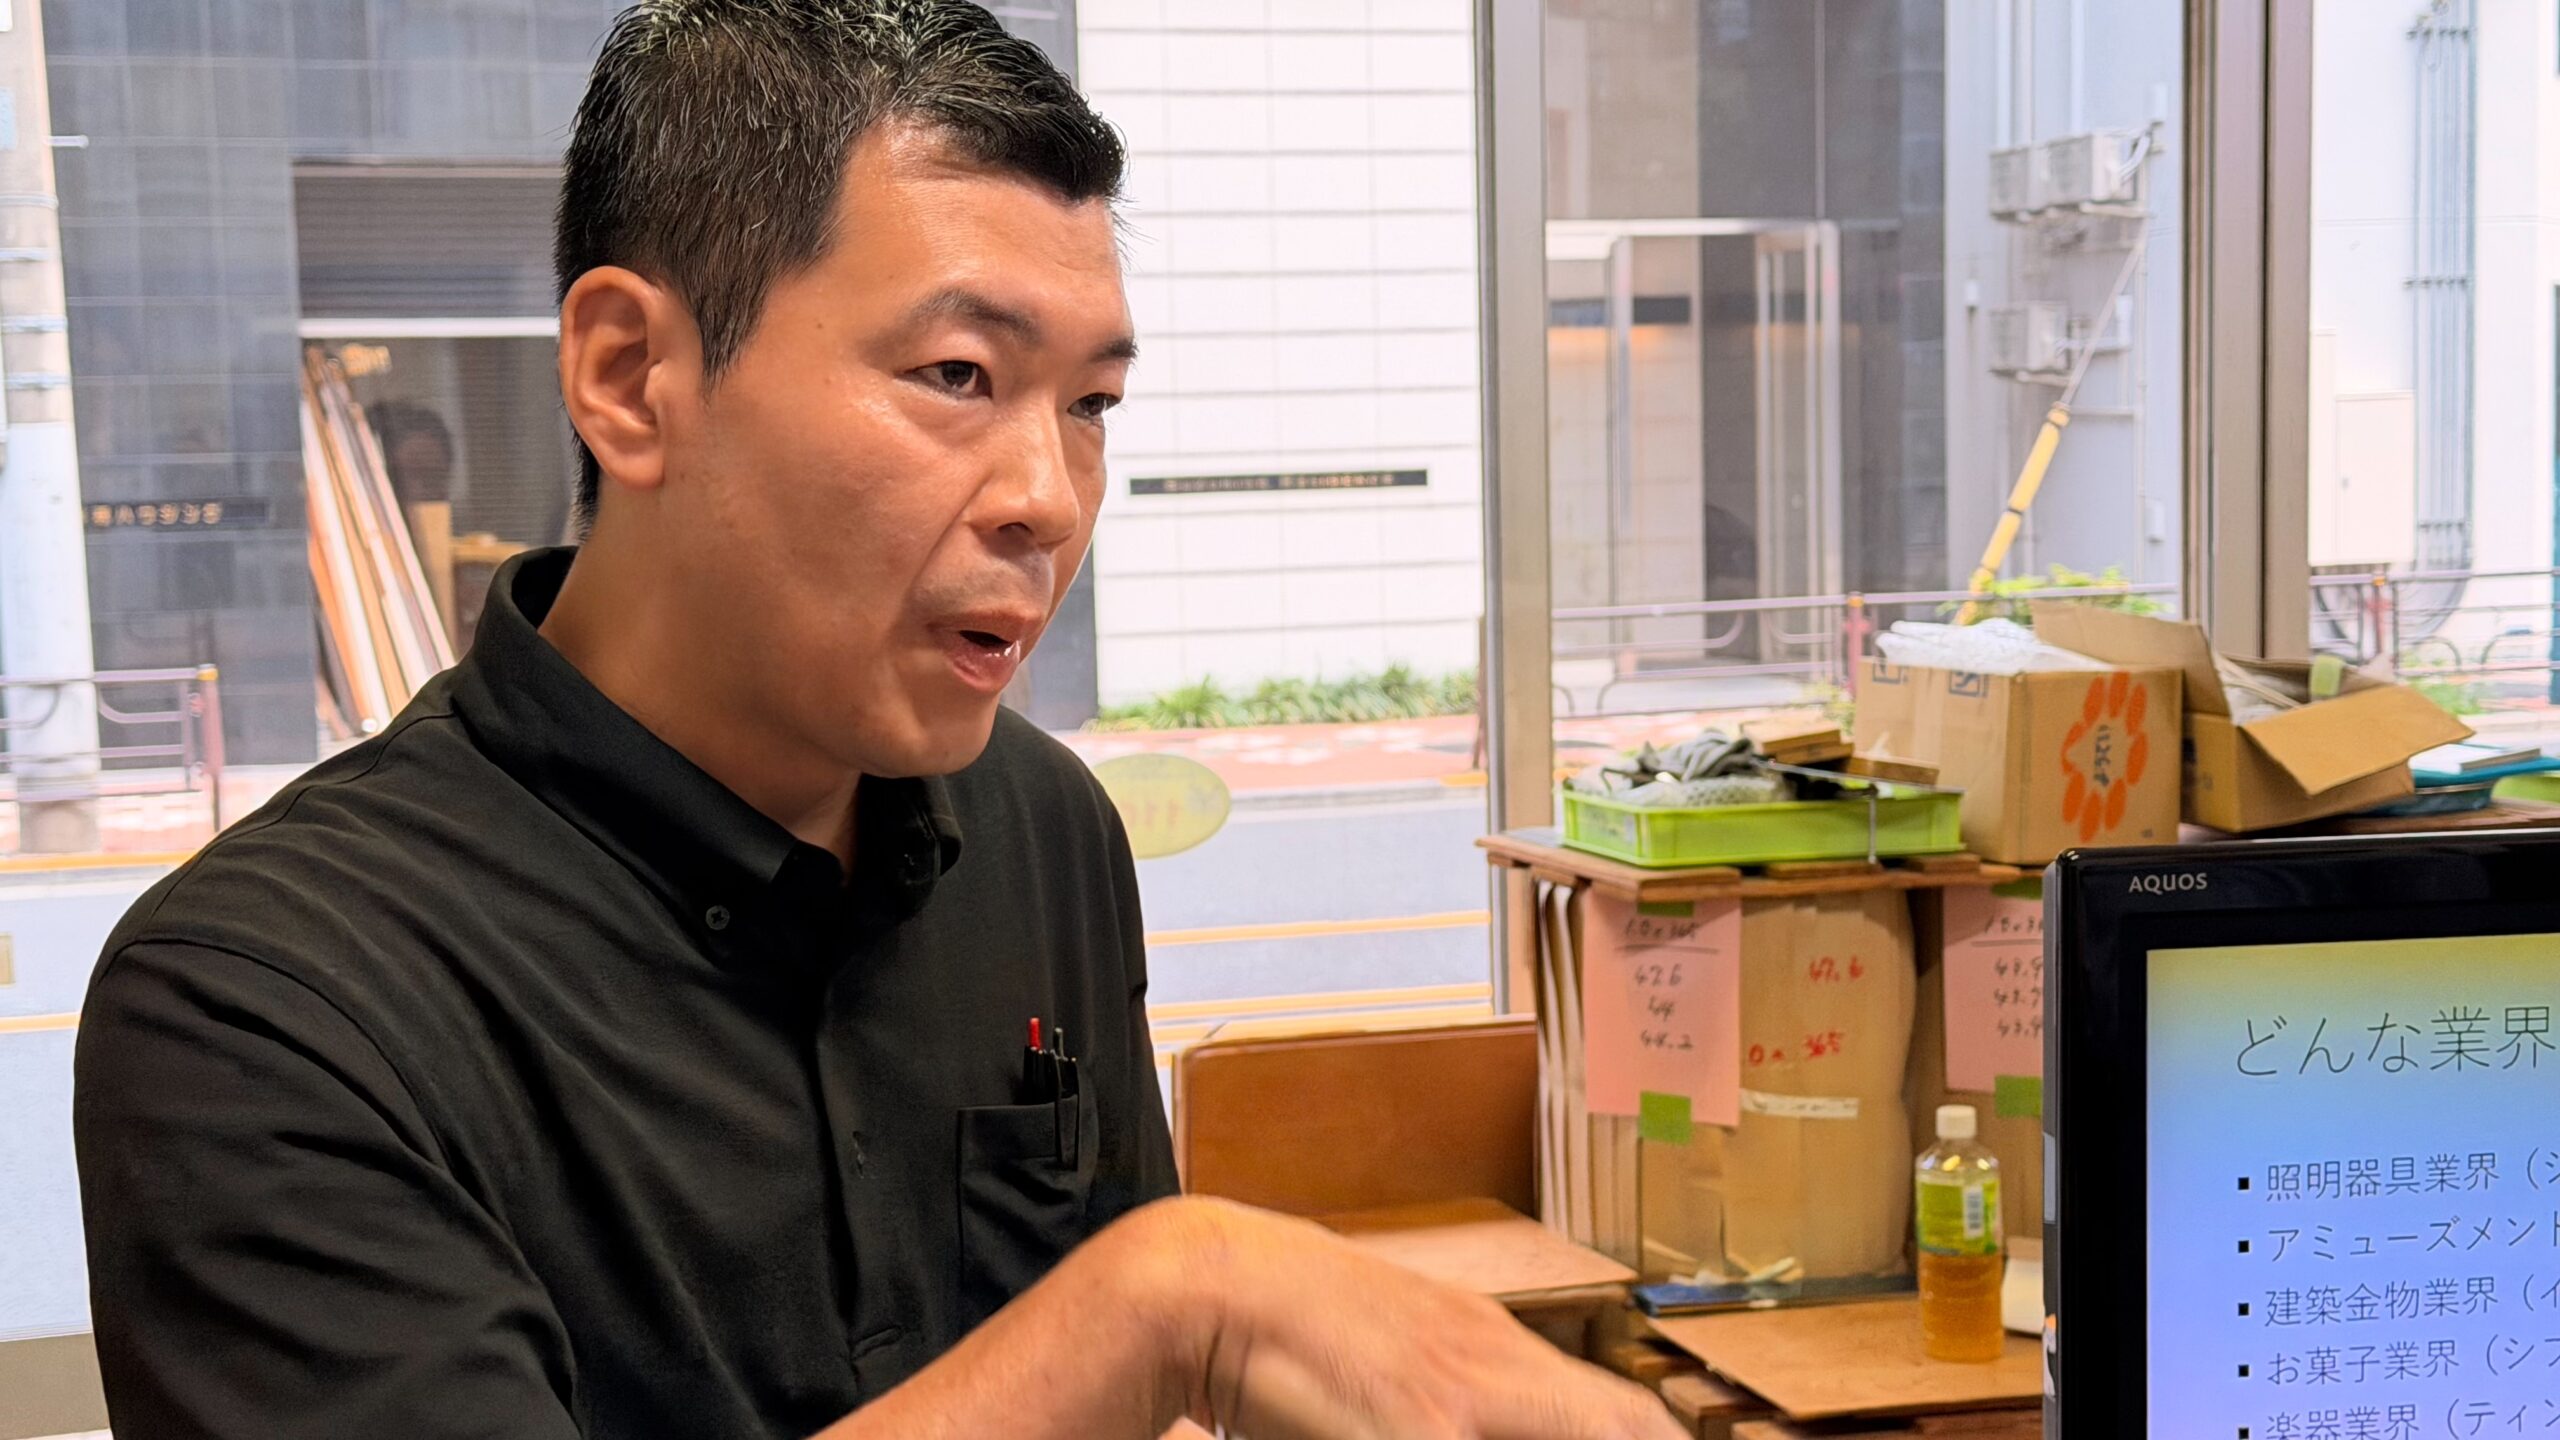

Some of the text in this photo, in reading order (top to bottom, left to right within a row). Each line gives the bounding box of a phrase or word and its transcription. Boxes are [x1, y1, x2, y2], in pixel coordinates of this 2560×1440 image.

[2127, 872, 2208, 895] AQUOS
[2236, 1005, 2557, 1076] どんな業界
